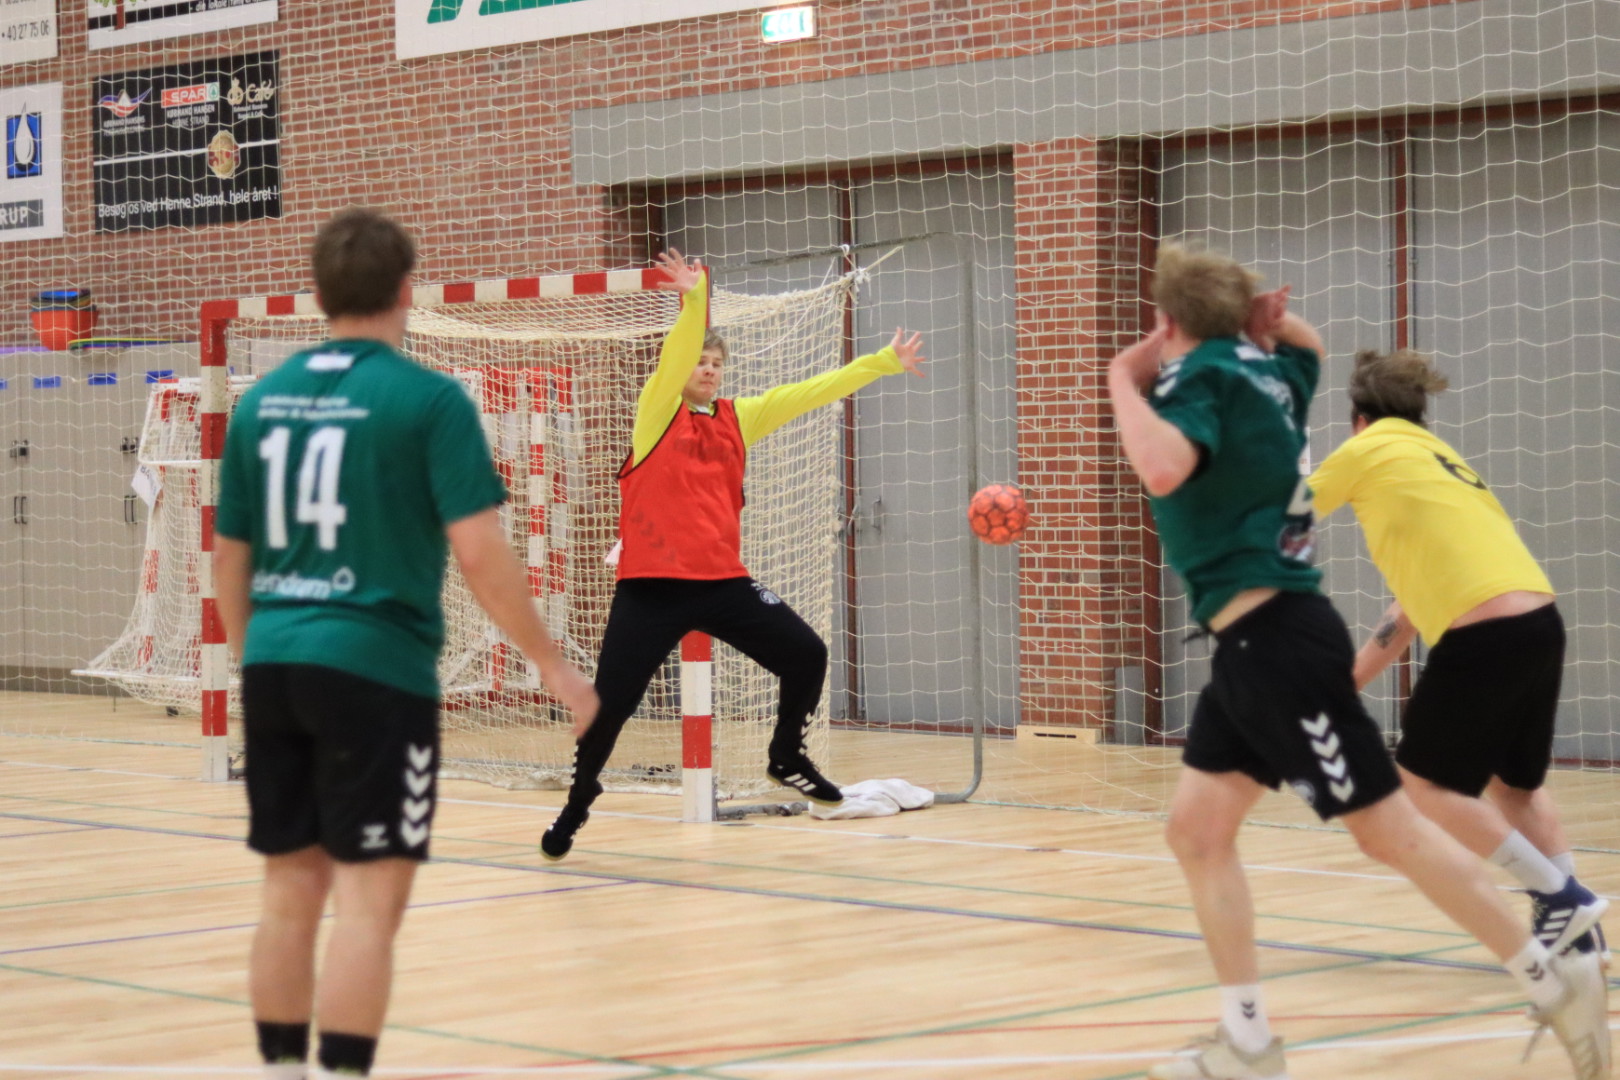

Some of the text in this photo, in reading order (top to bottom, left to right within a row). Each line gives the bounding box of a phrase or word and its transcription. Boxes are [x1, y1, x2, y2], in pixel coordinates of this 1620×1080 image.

[29, 21, 39, 38] 75
[171, 87, 206, 103] SPAR
[98, 203, 126, 219] Besøg
[128, 203, 140, 214] os
[141, 197, 158, 213] ved
[160, 197, 191, 214] Henne
[229, 189, 250, 205] hele
[252, 186, 272, 202] året
[259, 425, 347, 551] 14
